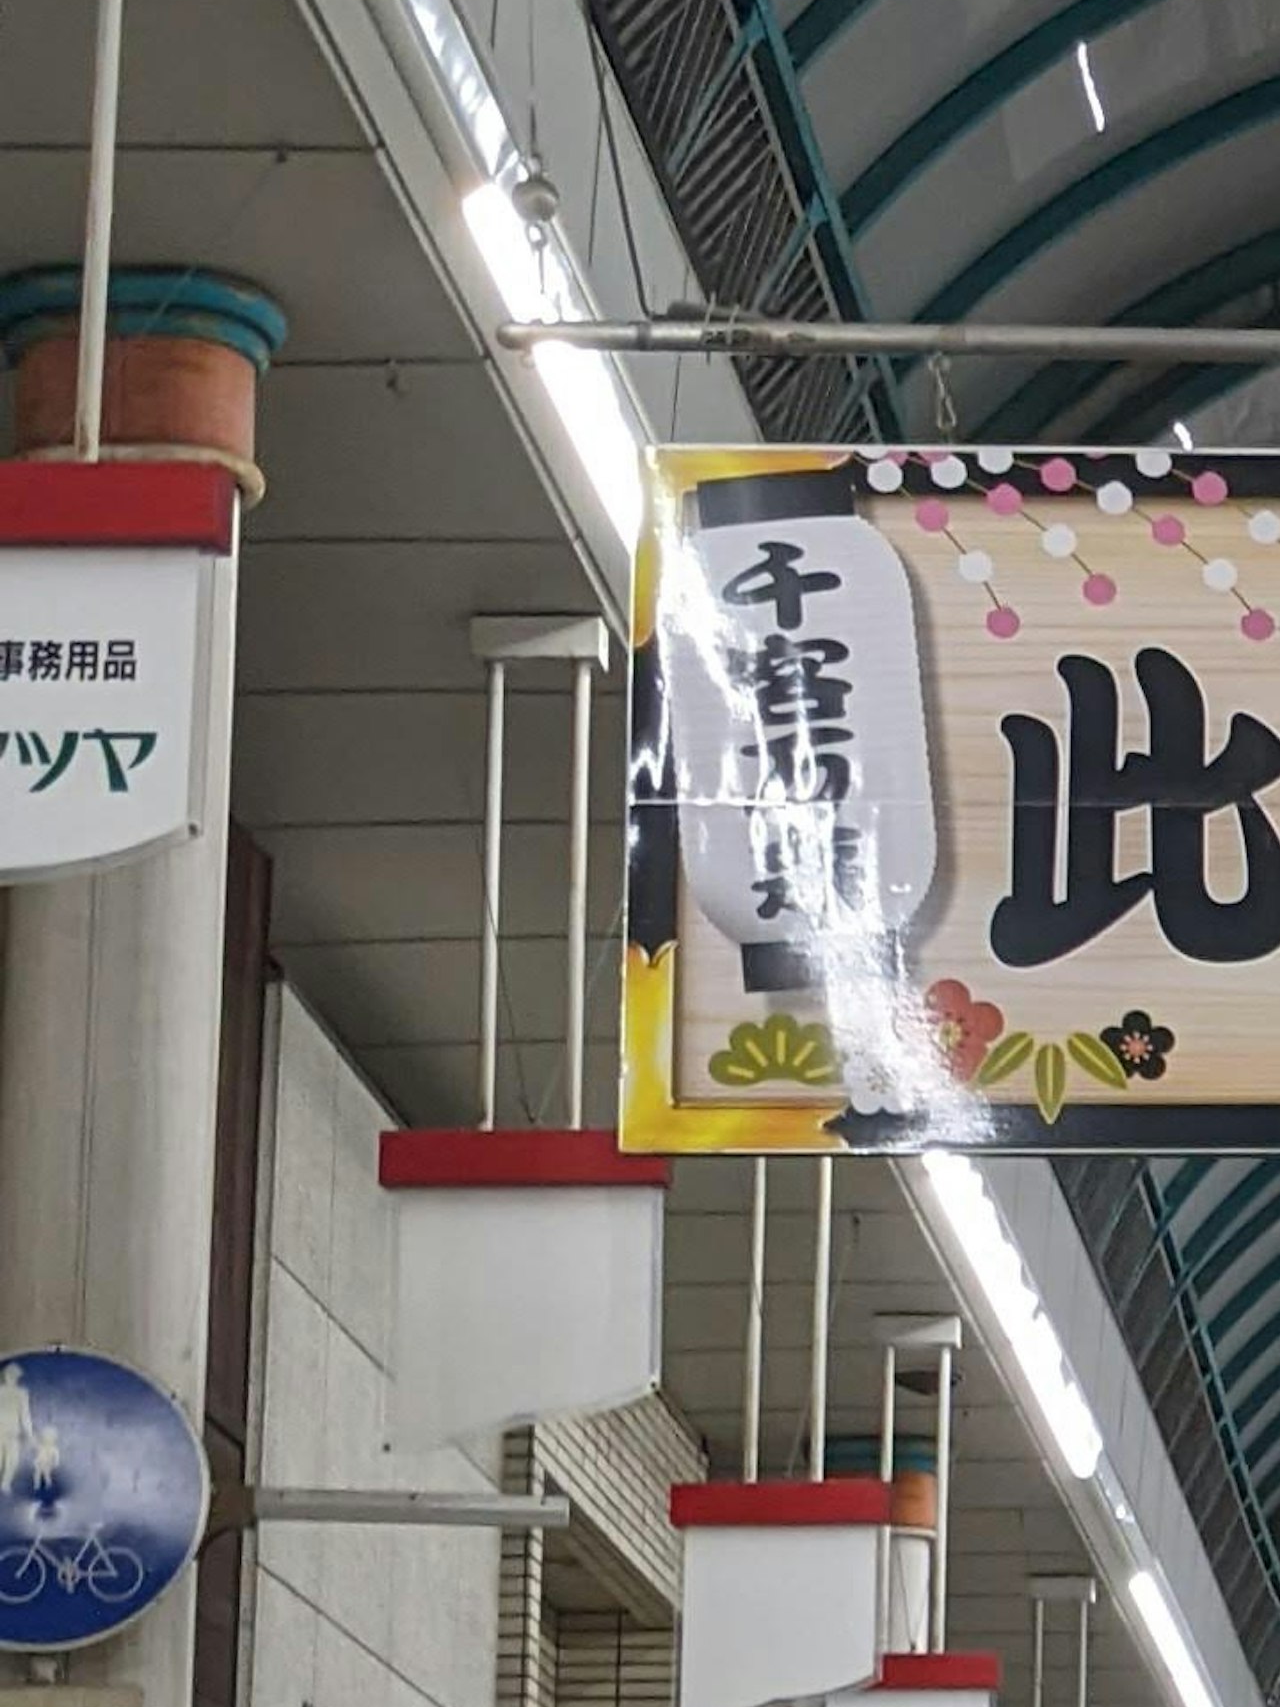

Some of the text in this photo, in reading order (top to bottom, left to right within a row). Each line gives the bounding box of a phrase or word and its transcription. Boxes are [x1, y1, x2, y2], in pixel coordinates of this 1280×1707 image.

[0, 640, 136, 681] 事務用品
[0, 728, 157, 793] ツヤ
